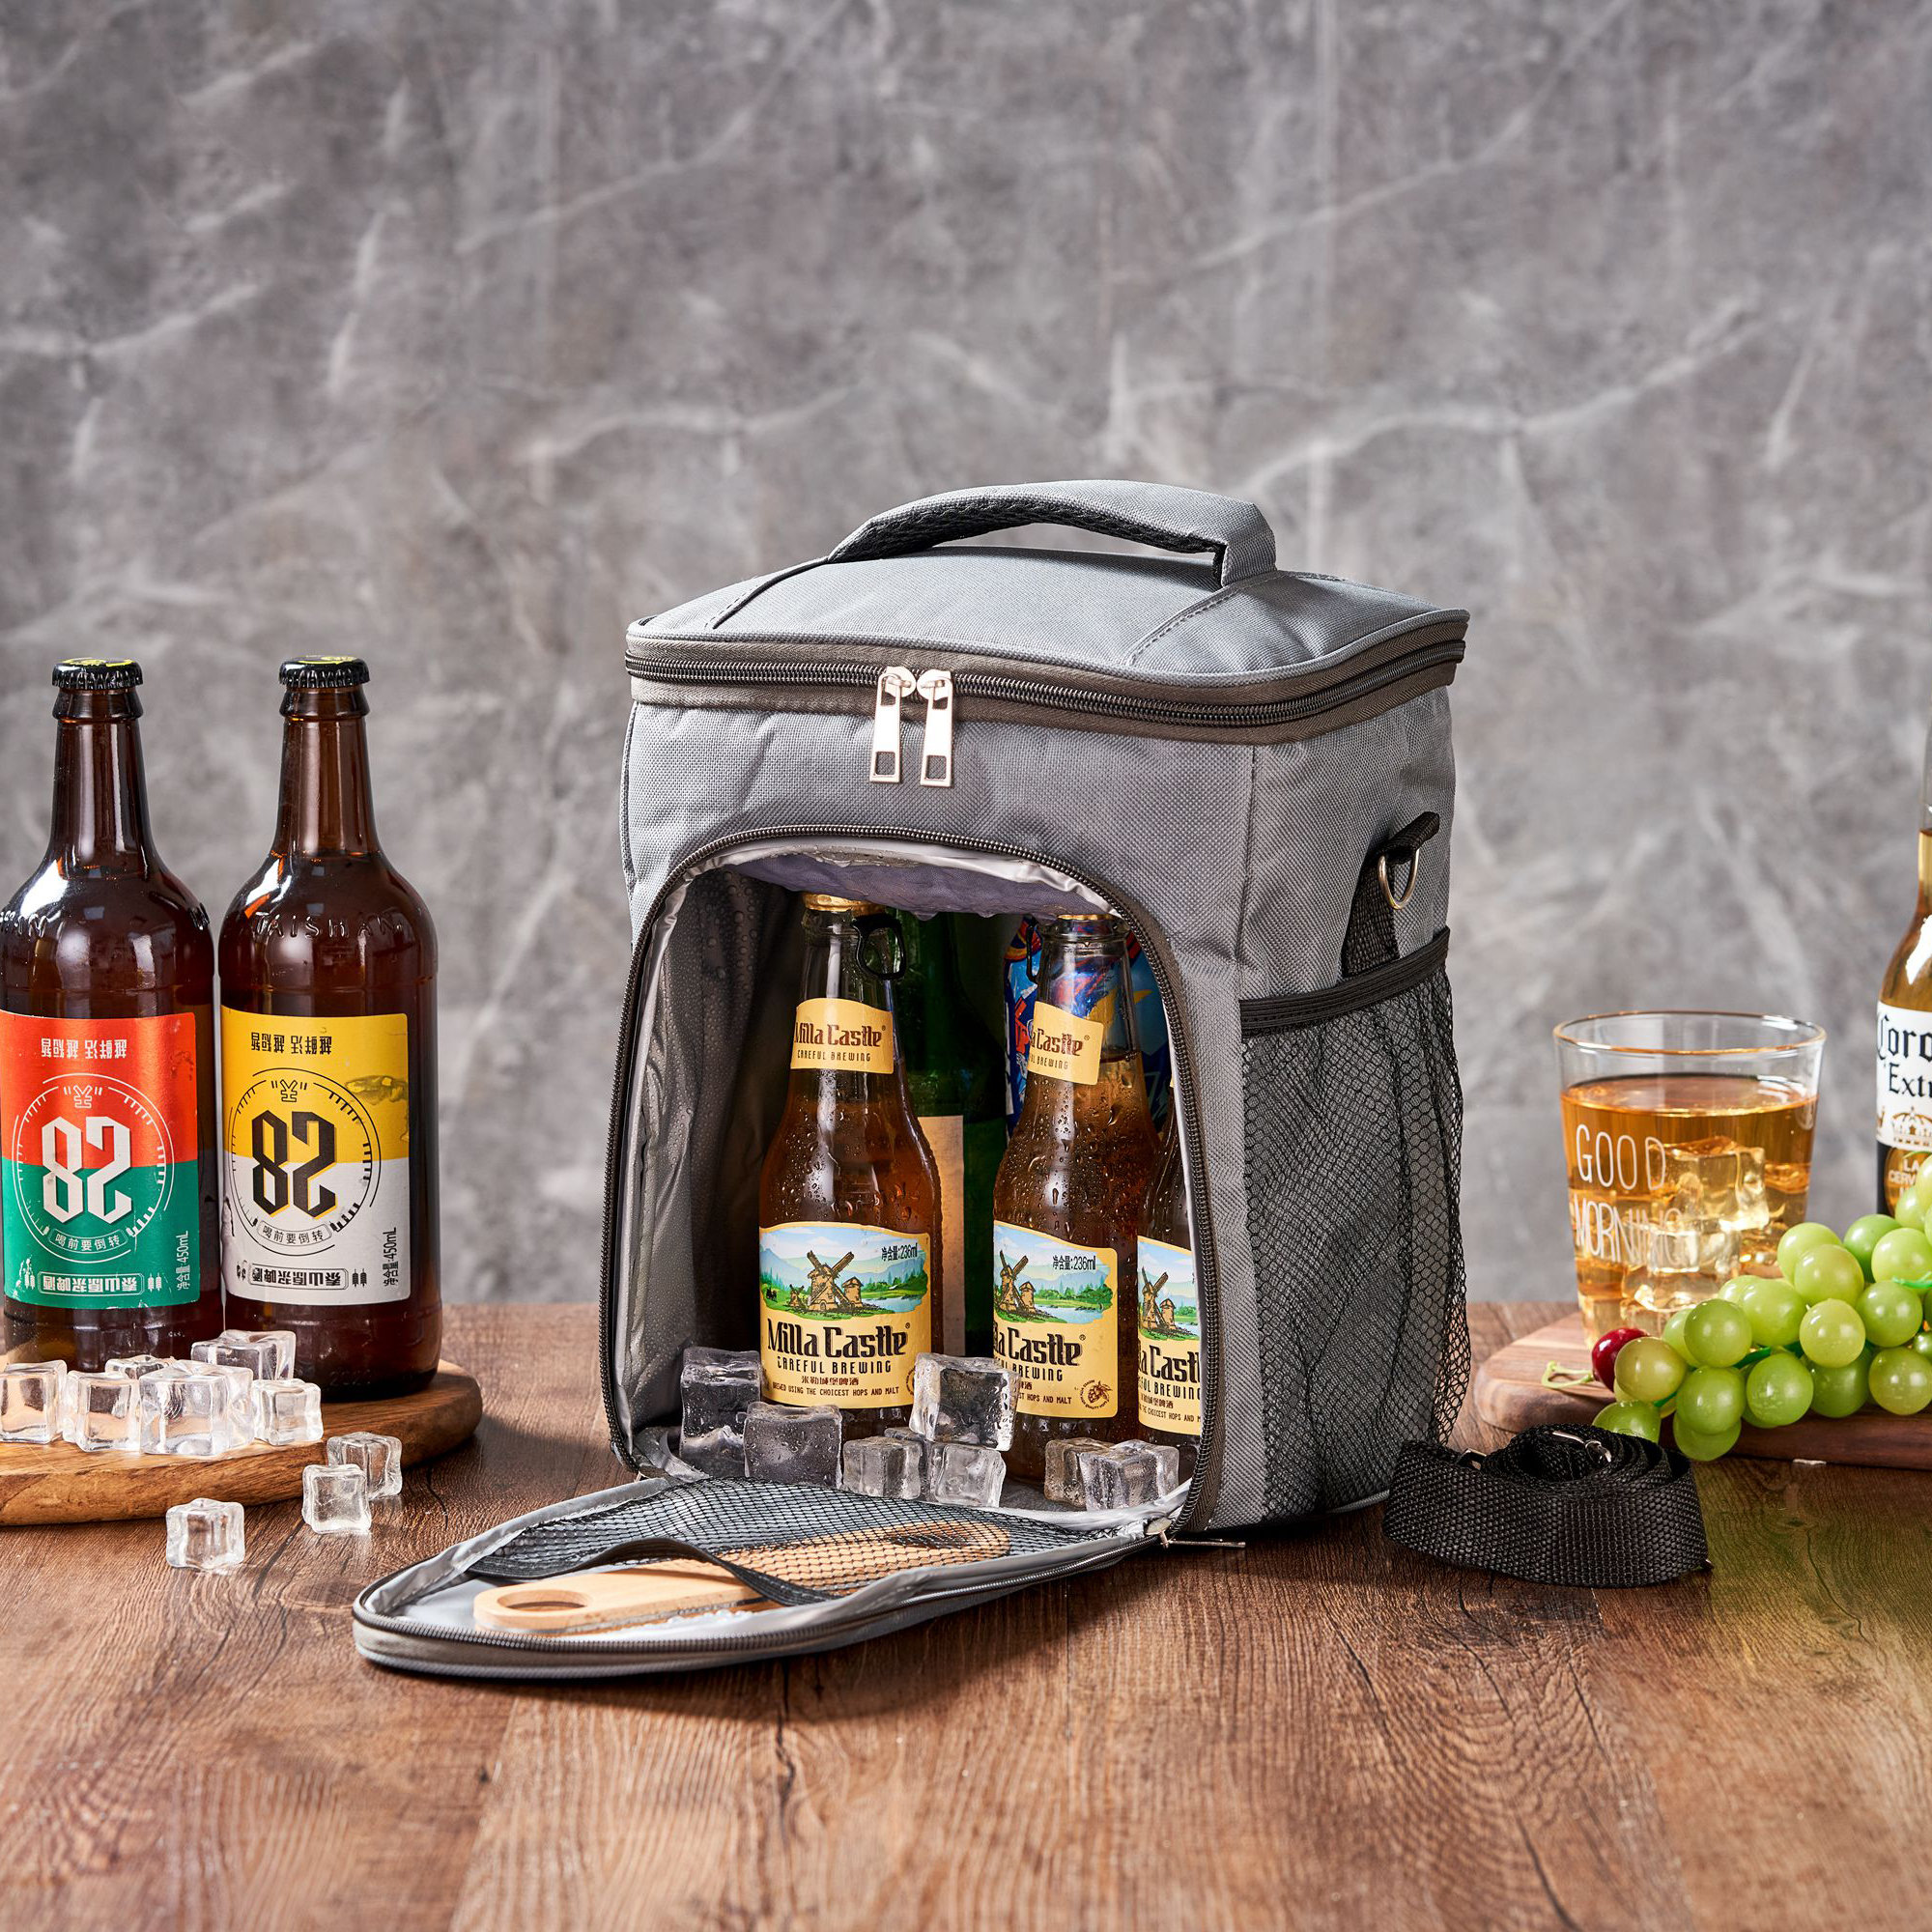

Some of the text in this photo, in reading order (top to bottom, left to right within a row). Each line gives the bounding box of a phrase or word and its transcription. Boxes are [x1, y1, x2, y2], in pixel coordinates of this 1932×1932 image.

[831, 1051, 871, 1062] BREWING
[1576, 1123, 1666, 1192] GOOD
[767, 1319, 820, 1357] Milla
[777, 1355, 892, 1375] CAREFUL BREWING
[819, 1388, 849, 1397] CHOICEST
[852, 1388, 868, 1397] HOPS
[885, 1386, 899, 1395] MALT
[1043, 1395, 1054, 1404] AND
[1183, 1414, 1195, 1423] AND
